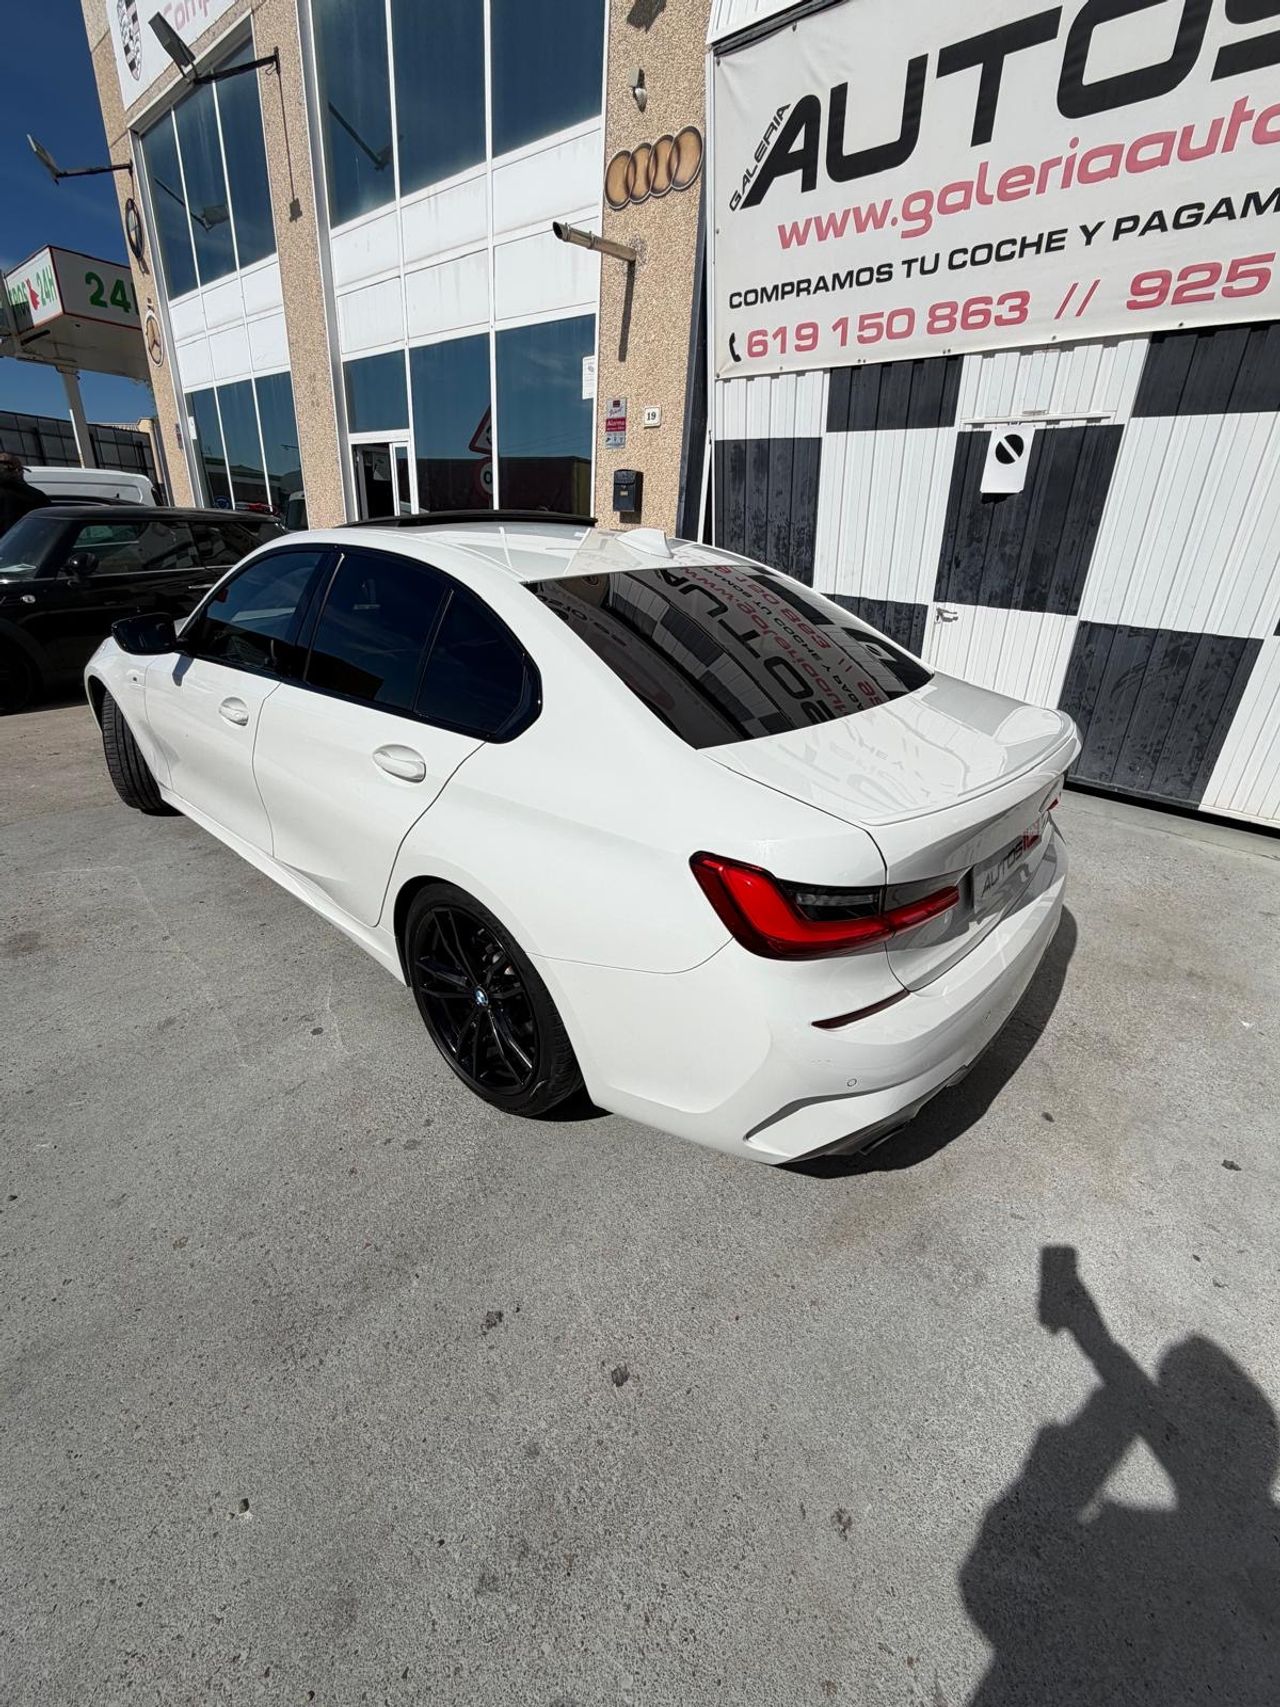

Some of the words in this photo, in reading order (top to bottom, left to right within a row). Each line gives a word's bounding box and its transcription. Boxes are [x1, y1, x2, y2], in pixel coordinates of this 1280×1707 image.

[729, 103, 792, 212] GALERIA
[84, 271, 140, 317] 24
[729, 262, 893, 309] COMPRAMOS
[902, 252, 940, 279] TU
[947, 228, 1068, 271] COCHE
[1079, 220, 1106, 247] Y
[1112, 186, 1280, 242] PAGAM
[747, 321, 819, 358] 619
[831, 307, 916, 348] 150
[926, 290, 1031, 336] 863
[1126, 252, 1277, 311] 925
[647, 411, 656, 421] 19
